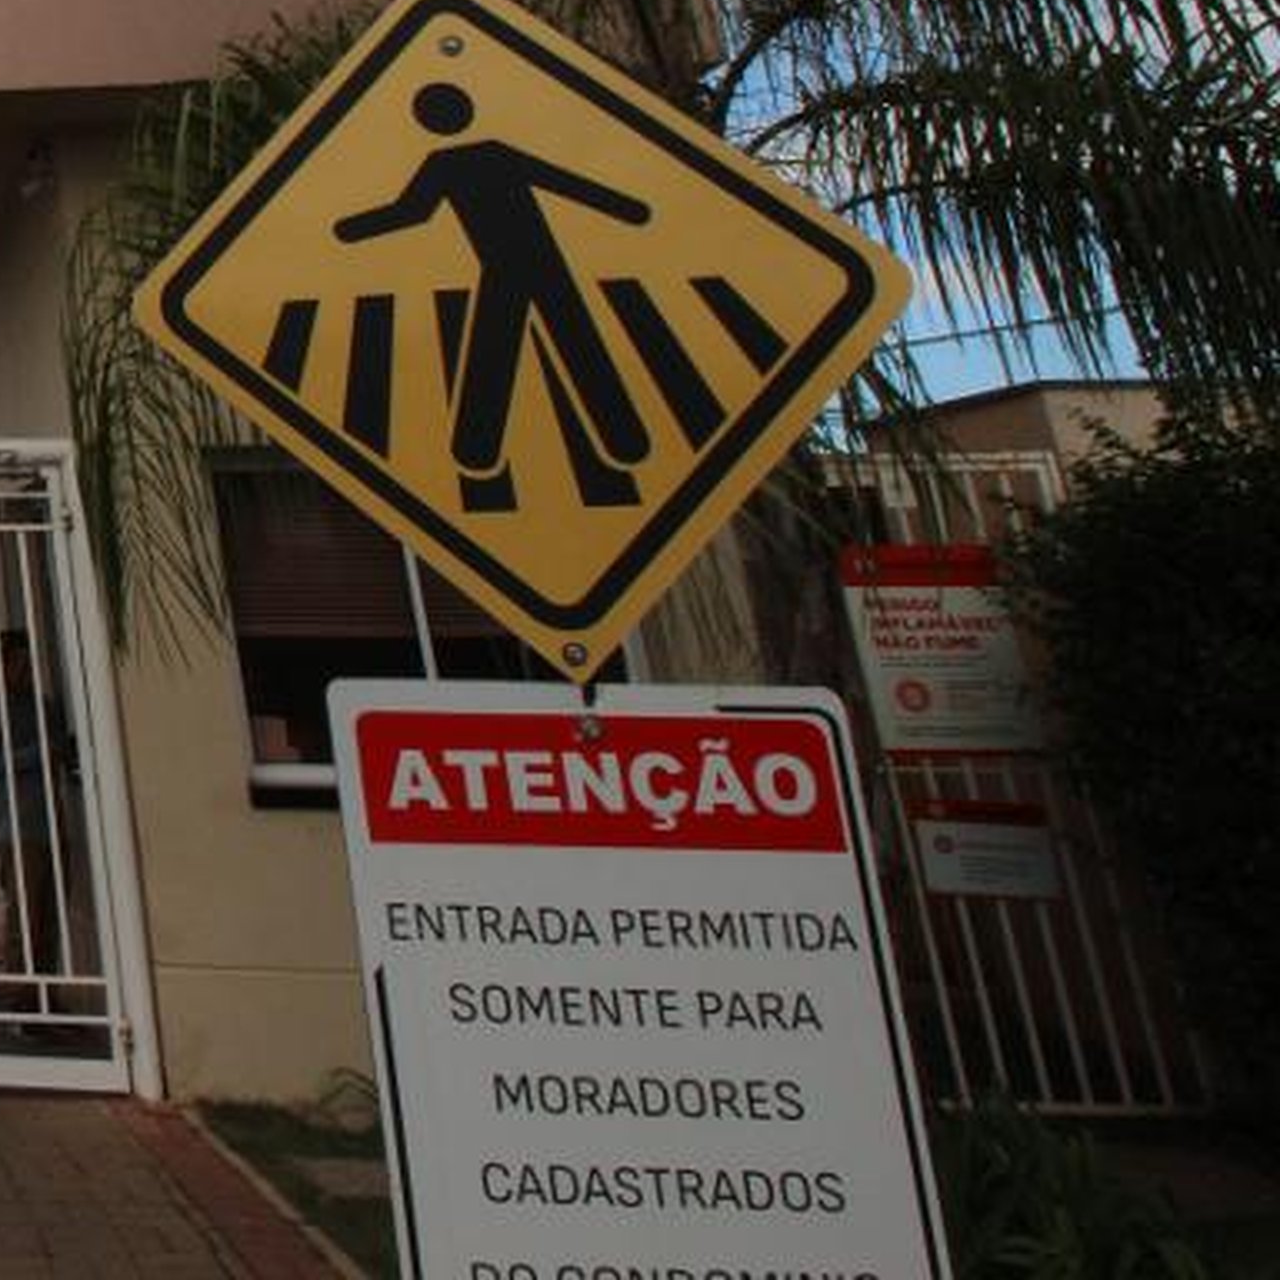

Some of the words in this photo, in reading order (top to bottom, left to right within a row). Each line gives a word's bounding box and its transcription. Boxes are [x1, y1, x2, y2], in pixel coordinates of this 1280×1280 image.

[387, 737, 819, 832] ATENÇÃO
[384, 901, 600, 947] ENTRADA
[612, 909, 859, 953] PERMITIDA
[447, 981, 683, 1031] SOMENTE
[696, 990, 824, 1033] PARA
[492, 1072, 807, 1123] MORADORES
[480, 1160, 847, 1214] CADASTRADOS
